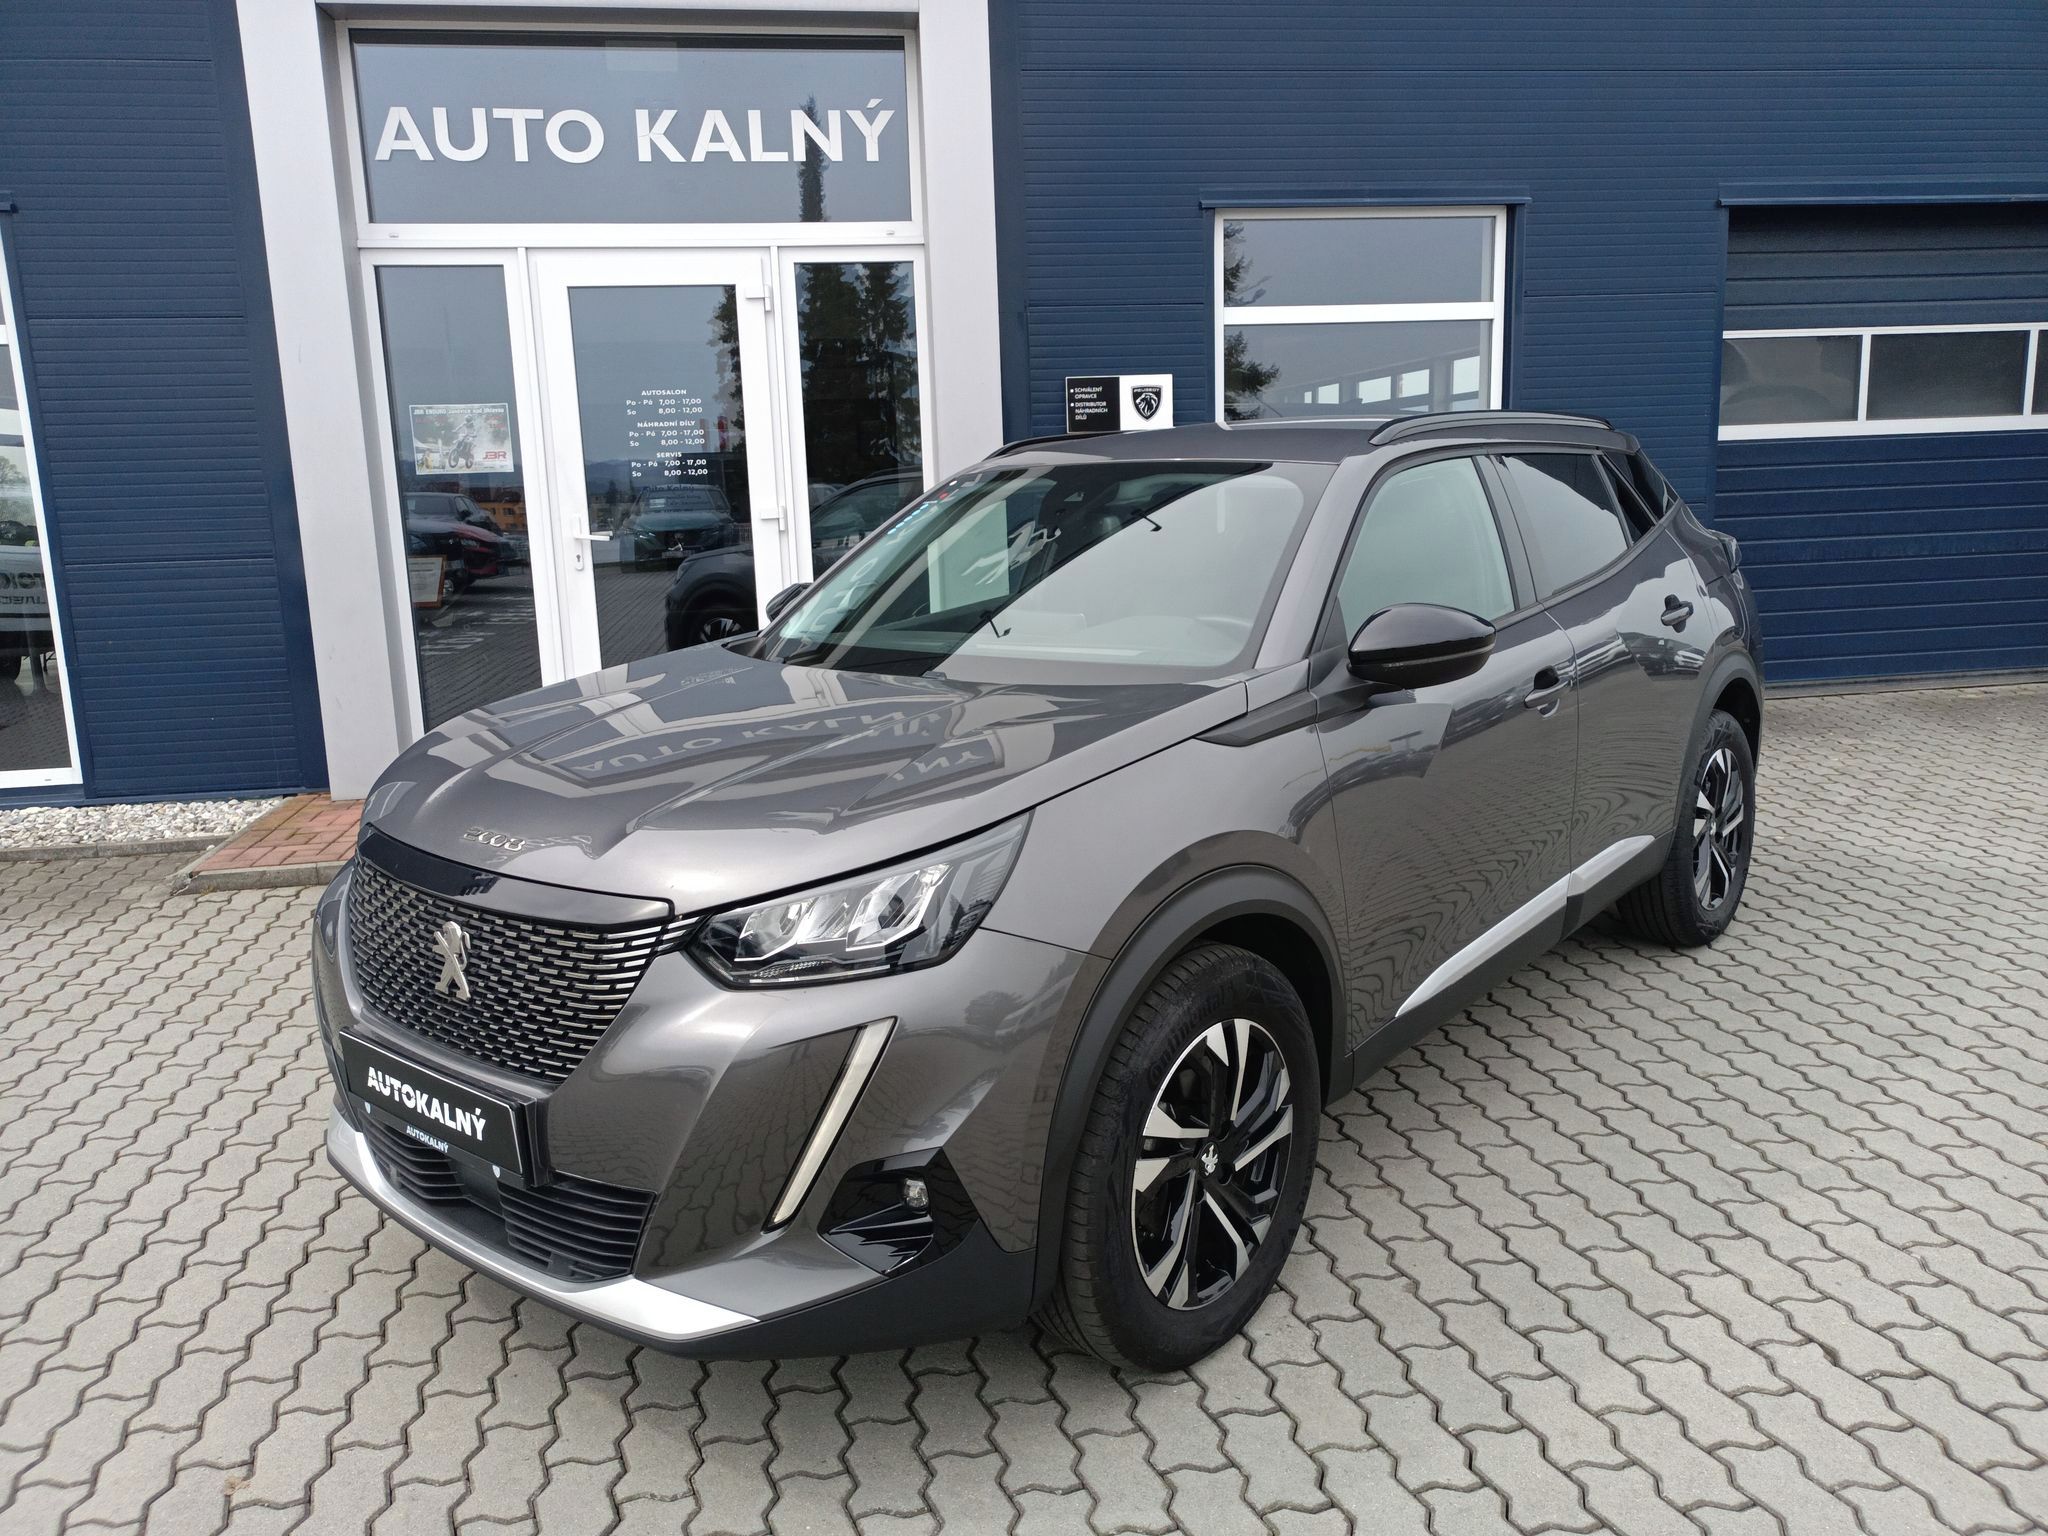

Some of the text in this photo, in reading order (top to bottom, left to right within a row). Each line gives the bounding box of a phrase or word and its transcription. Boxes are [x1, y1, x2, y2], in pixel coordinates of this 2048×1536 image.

[374, 98, 896, 164] AUTO KALNÝ
[658, 407, 676, 415] 8,00
[688, 468, 708, 476] 12,00
[463, 826, 526, 852] 2008
[367, 1066, 487, 1141] AUTOKALNÝ
[406, 1125, 449, 1154] AUTOKALNÝ
